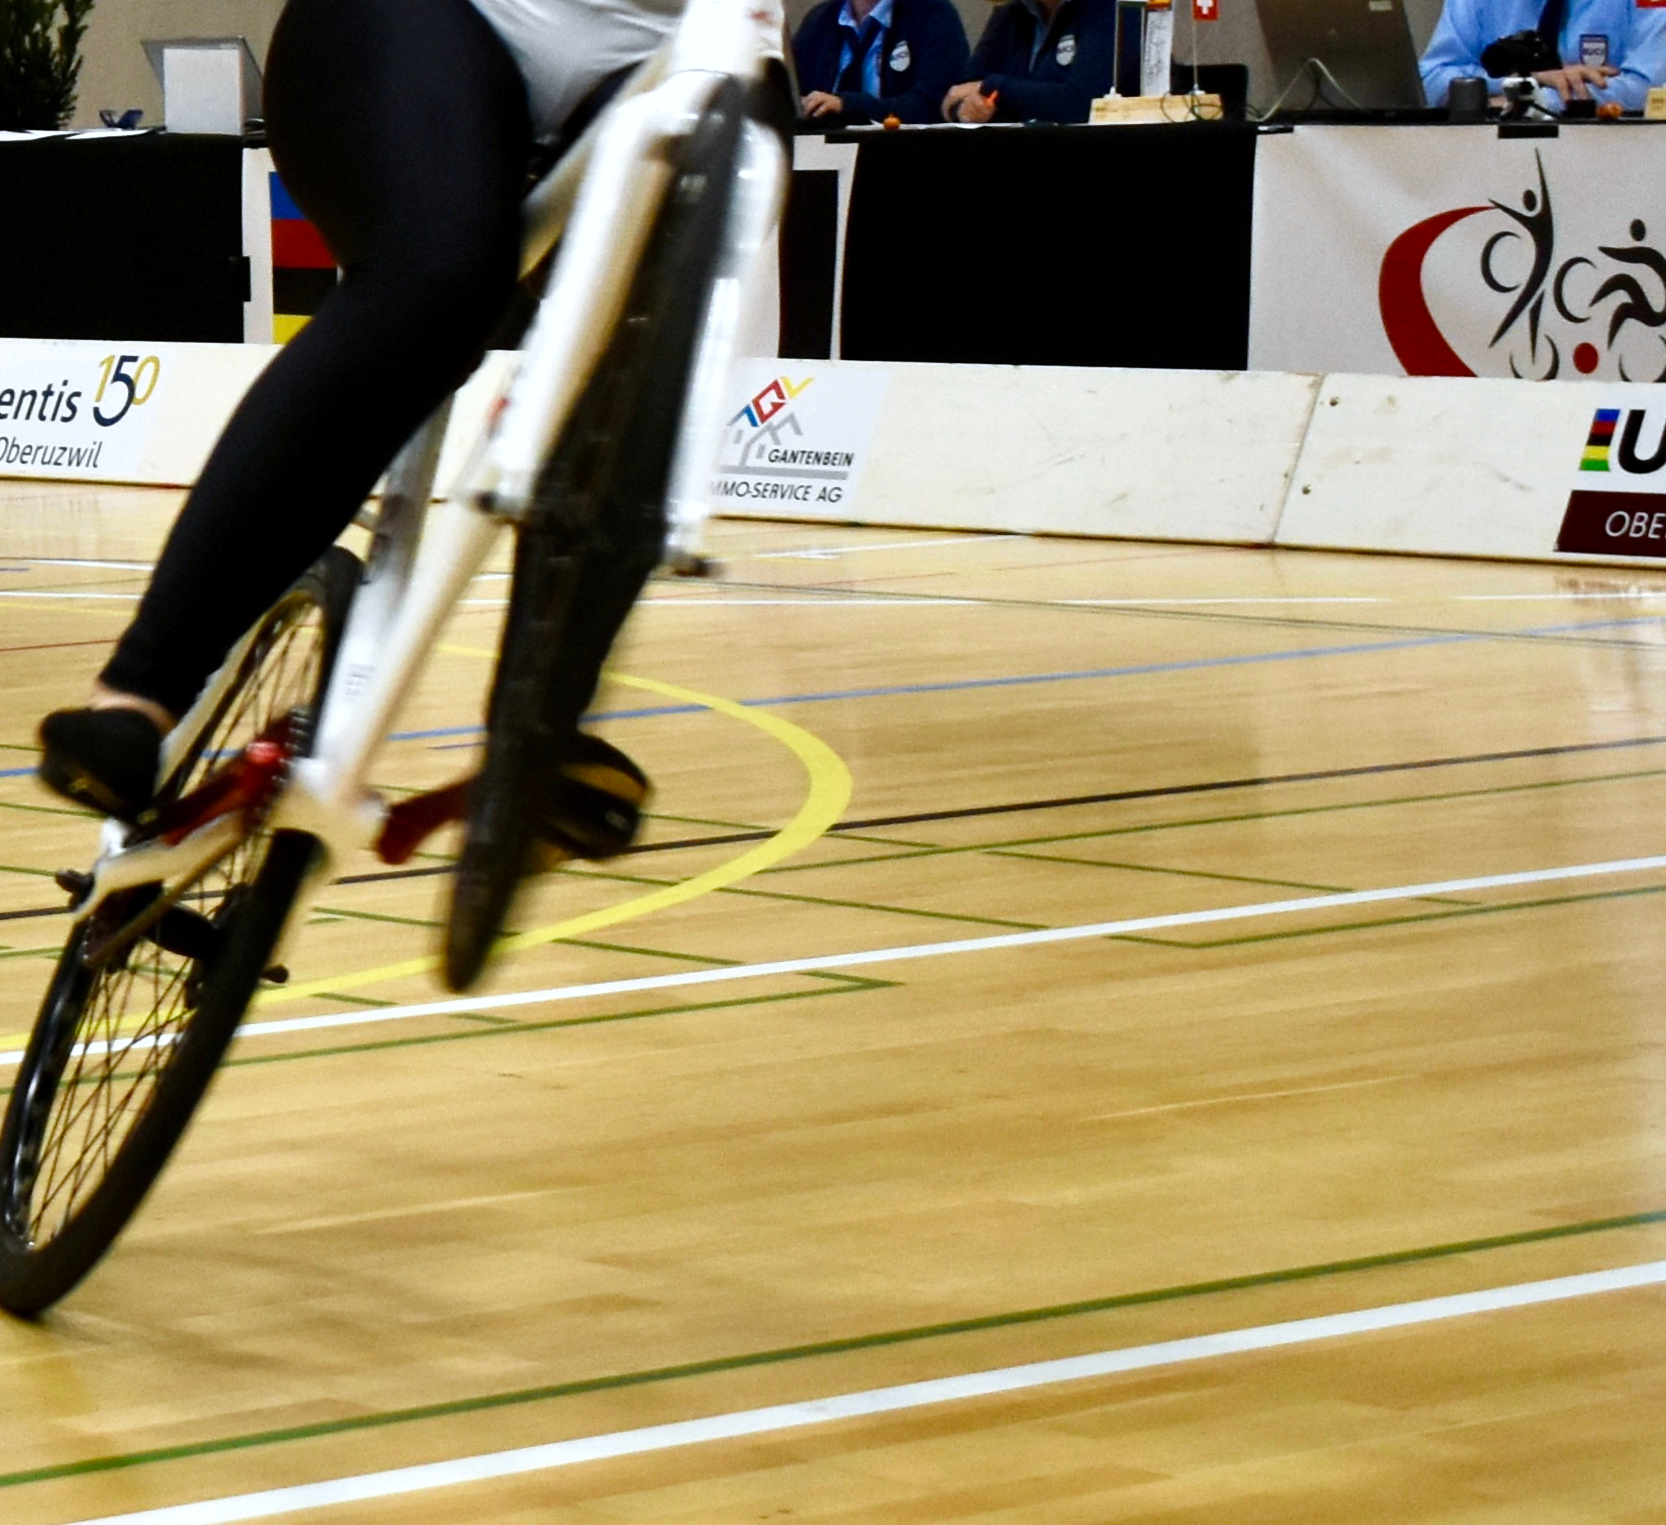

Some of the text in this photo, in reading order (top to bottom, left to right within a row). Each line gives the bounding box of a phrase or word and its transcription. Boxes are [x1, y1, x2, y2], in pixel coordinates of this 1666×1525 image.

[93, 355, 160, 427] 150
[768, 449, 855, 466] GANTENBEIN
[816, 486, 843, 503] AG
